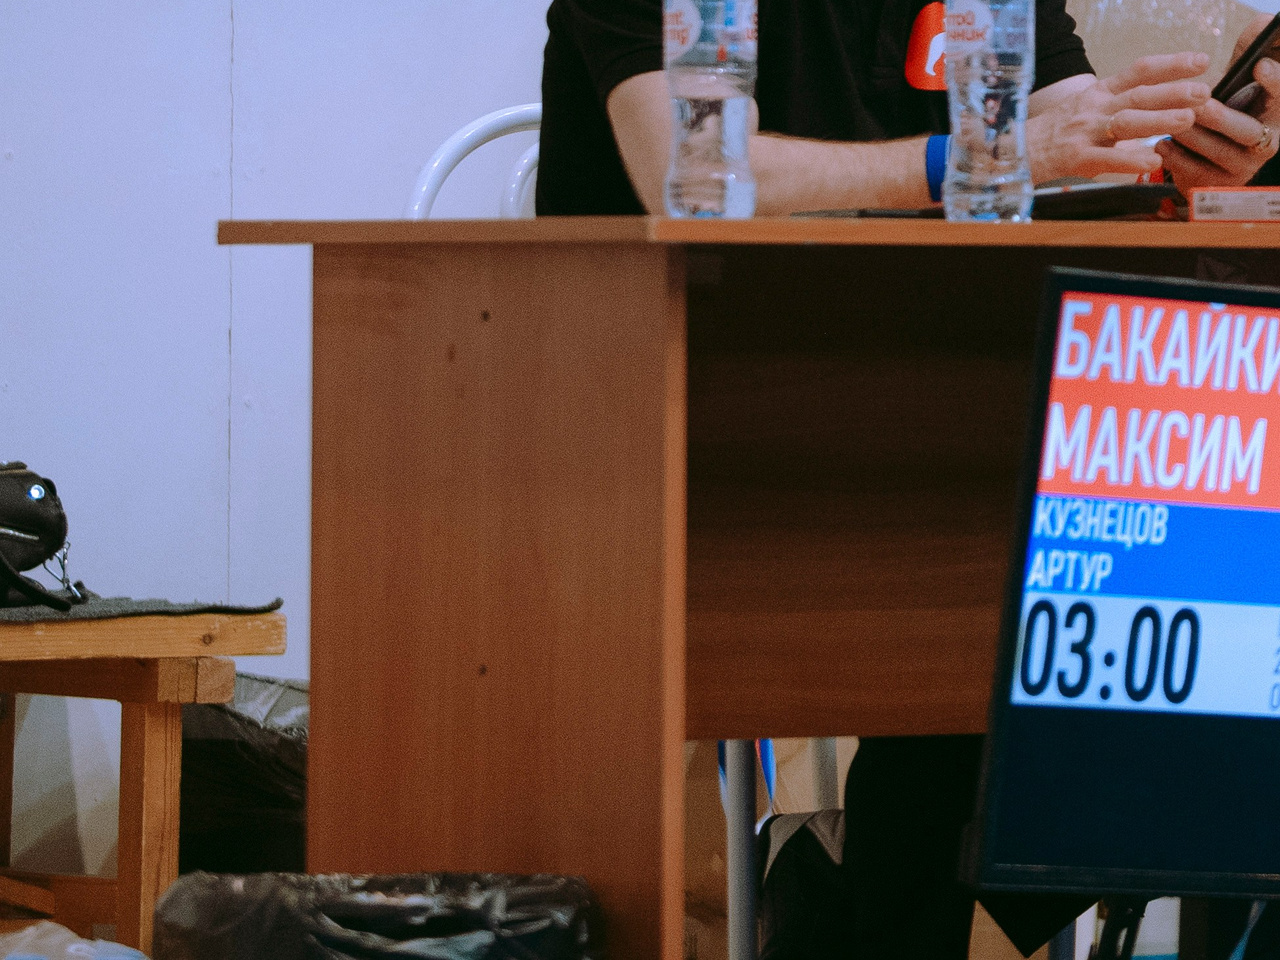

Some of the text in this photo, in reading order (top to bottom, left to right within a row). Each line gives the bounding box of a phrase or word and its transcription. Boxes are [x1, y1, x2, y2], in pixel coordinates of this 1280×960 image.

[1040, 402, 1269, 495] МАКСИМ
[1033, 496, 1170, 549] КУЗНЕЦОВ
[1027, 548, 1113, 591] АРТУР
[1020, 599, 1200, 704] 03:00
